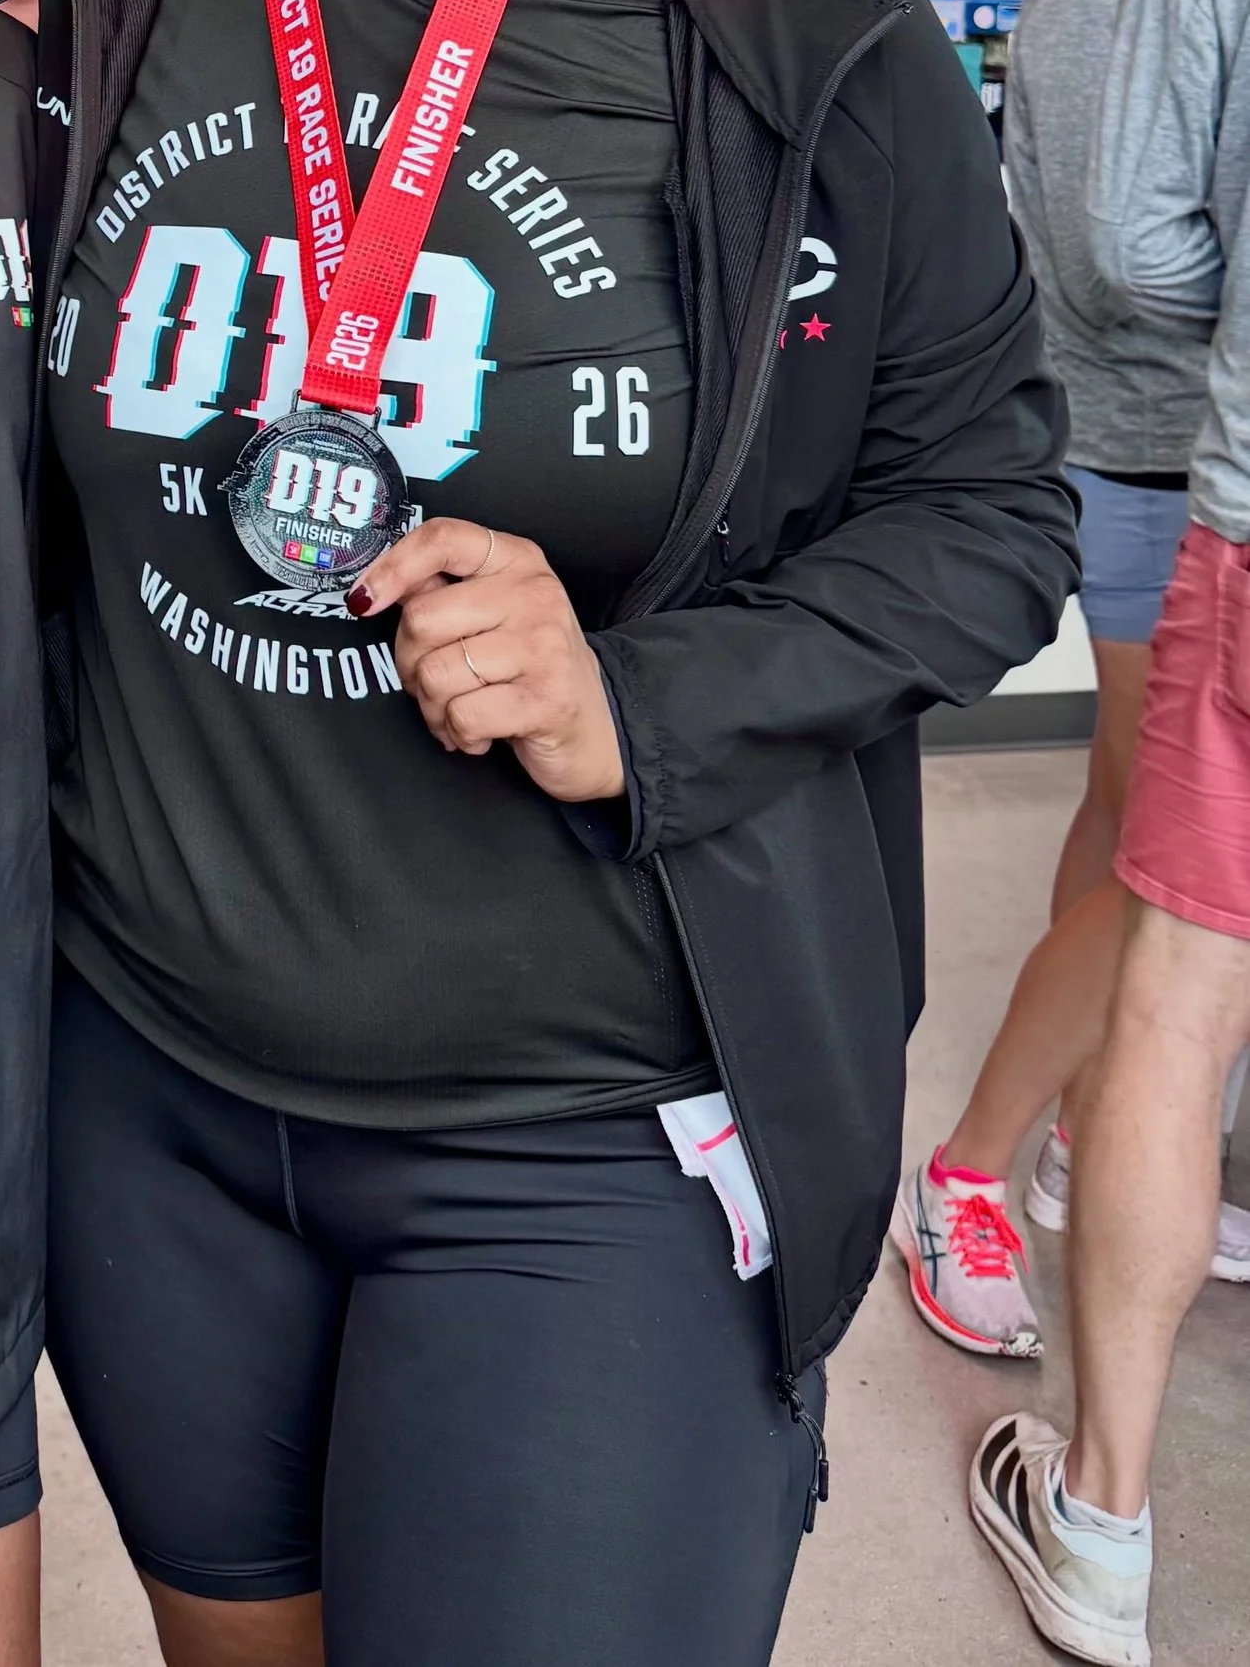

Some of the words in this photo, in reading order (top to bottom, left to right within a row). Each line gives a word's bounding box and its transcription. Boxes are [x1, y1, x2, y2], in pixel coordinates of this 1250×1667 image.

[287, 38, 317, 82] 19
[94, 102, 257, 244] DISTRICT
[295, 82, 333, 176] RACE
[325, 310, 379, 372] 2026
[390, 39, 475, 198] FINISHER
[466, 147, 618, 300] SERIES
[571, 365, 651, 457] 26
[158, 462, 208, 517] 5K
[264, 449, 378, 530] D19
[275, 517, 353, 549] FINISHER
[139, 561, 403, 701] WASHINGTON
[233, 590, 352, 620] ALTRA
